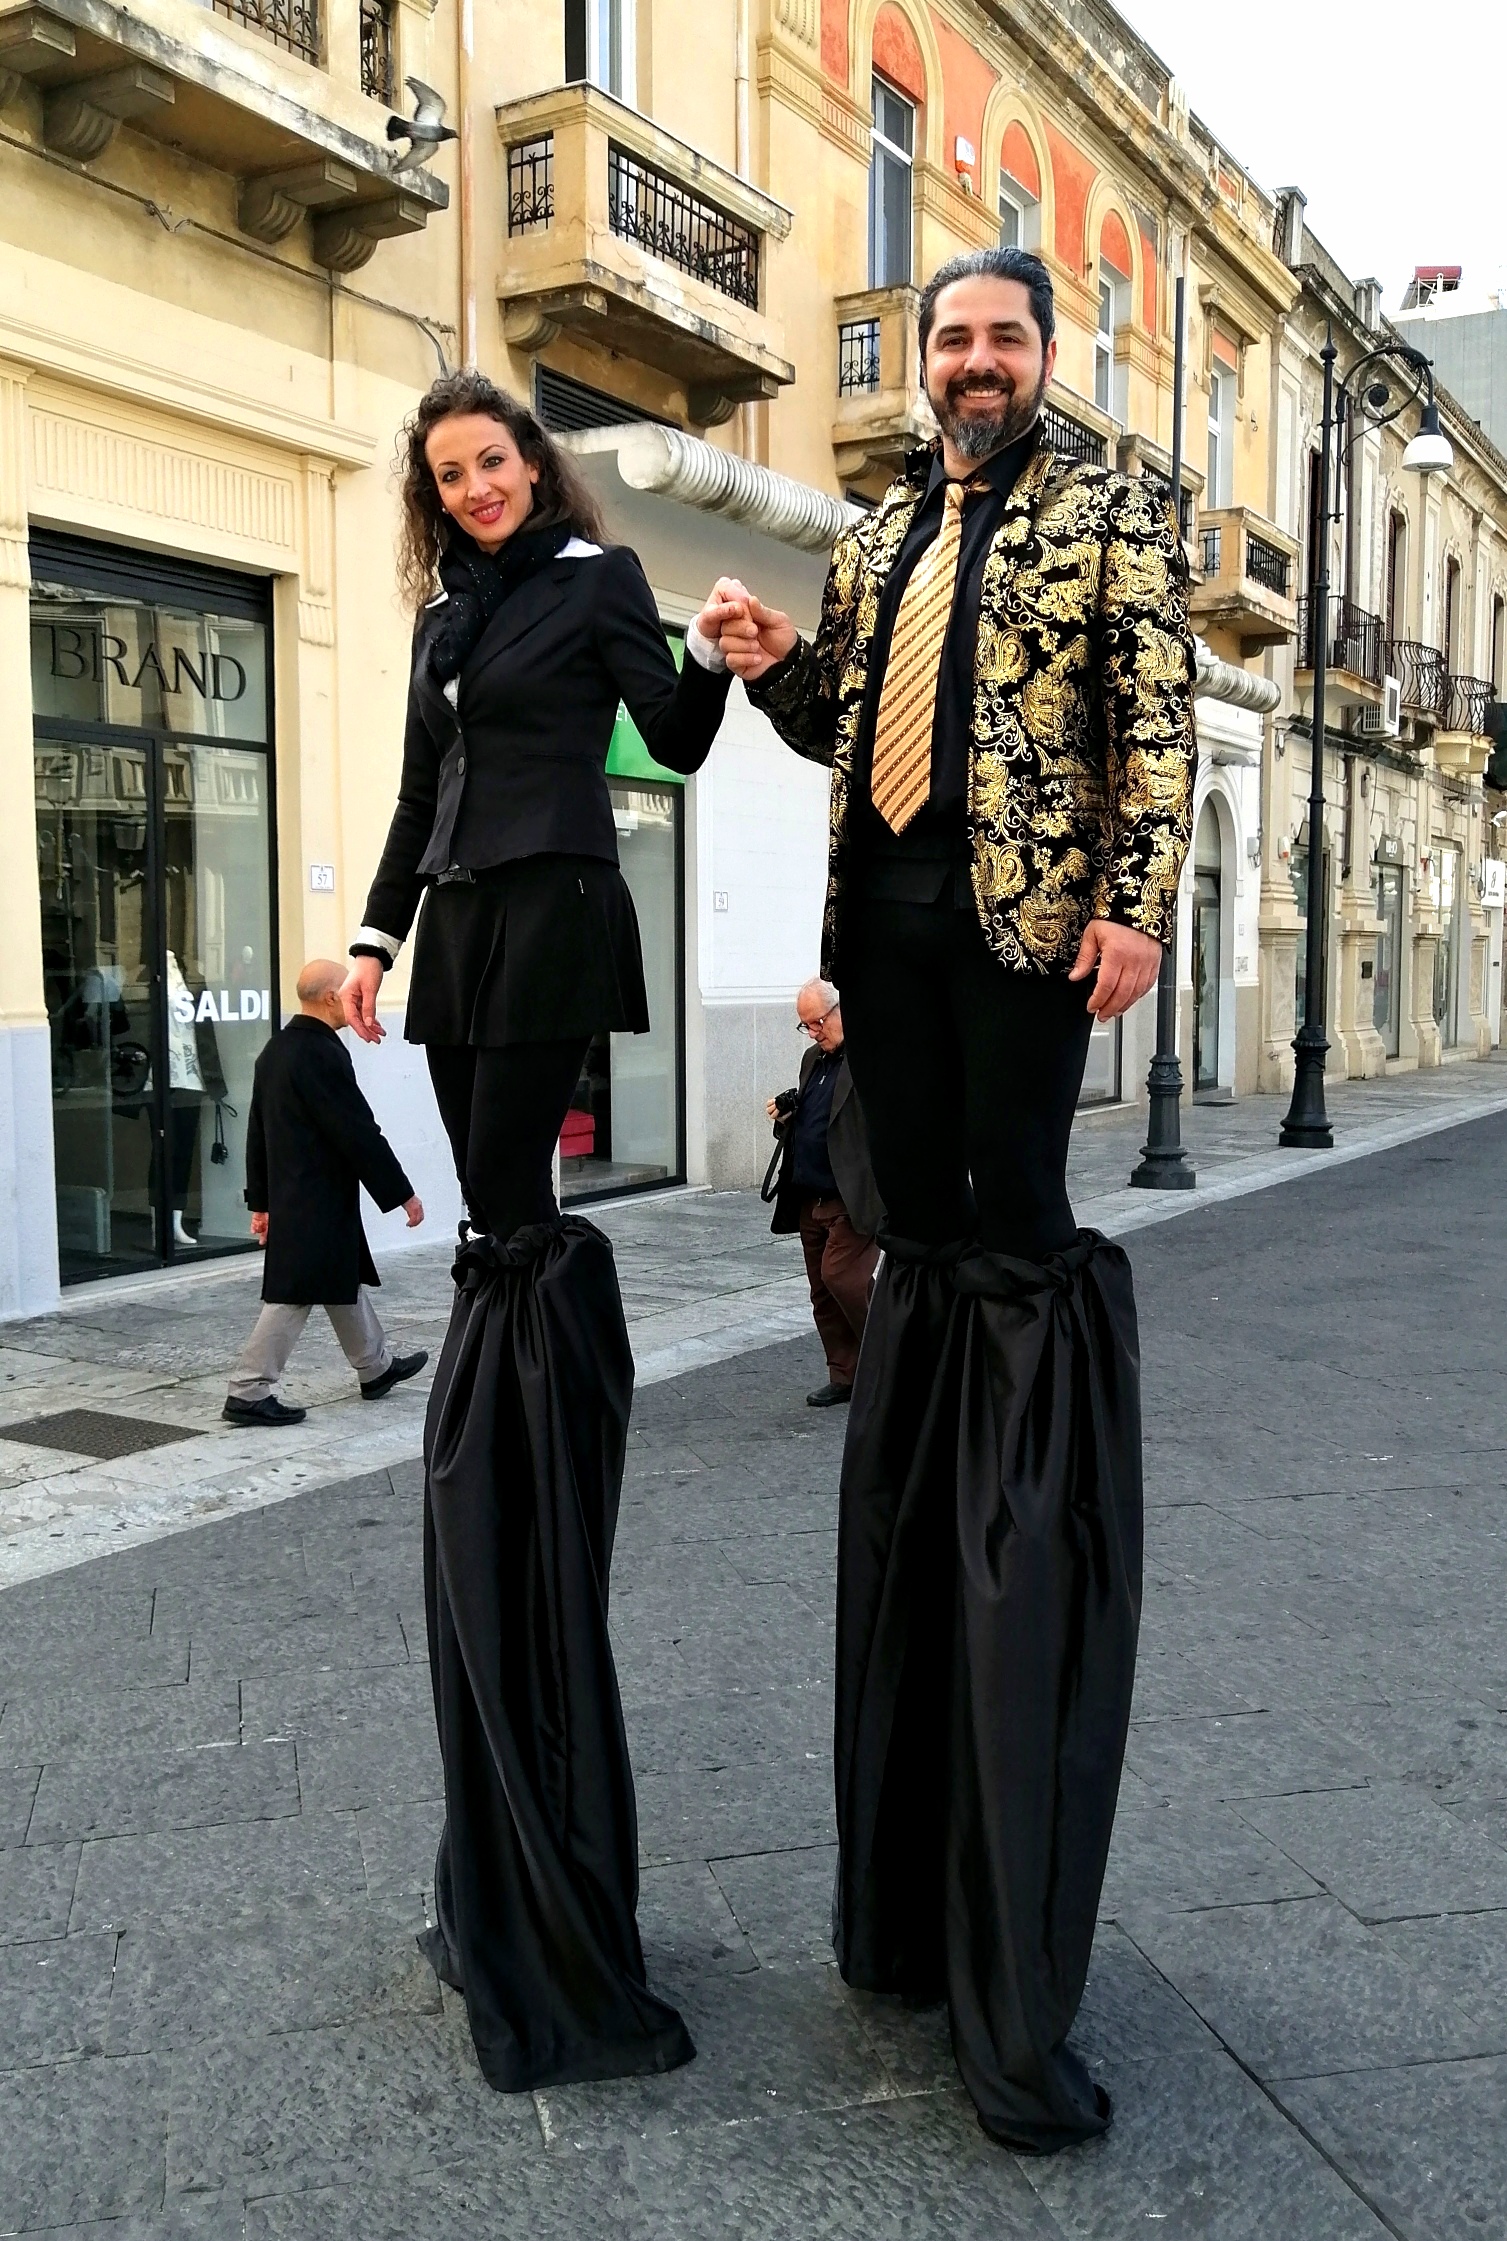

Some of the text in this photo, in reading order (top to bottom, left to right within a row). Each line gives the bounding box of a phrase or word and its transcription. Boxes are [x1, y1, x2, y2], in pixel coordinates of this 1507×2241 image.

[50, 625, 246, 701] BRAND
[317, 873, 328, 885] 57
[173, 989, 270, 1023] SALDI
